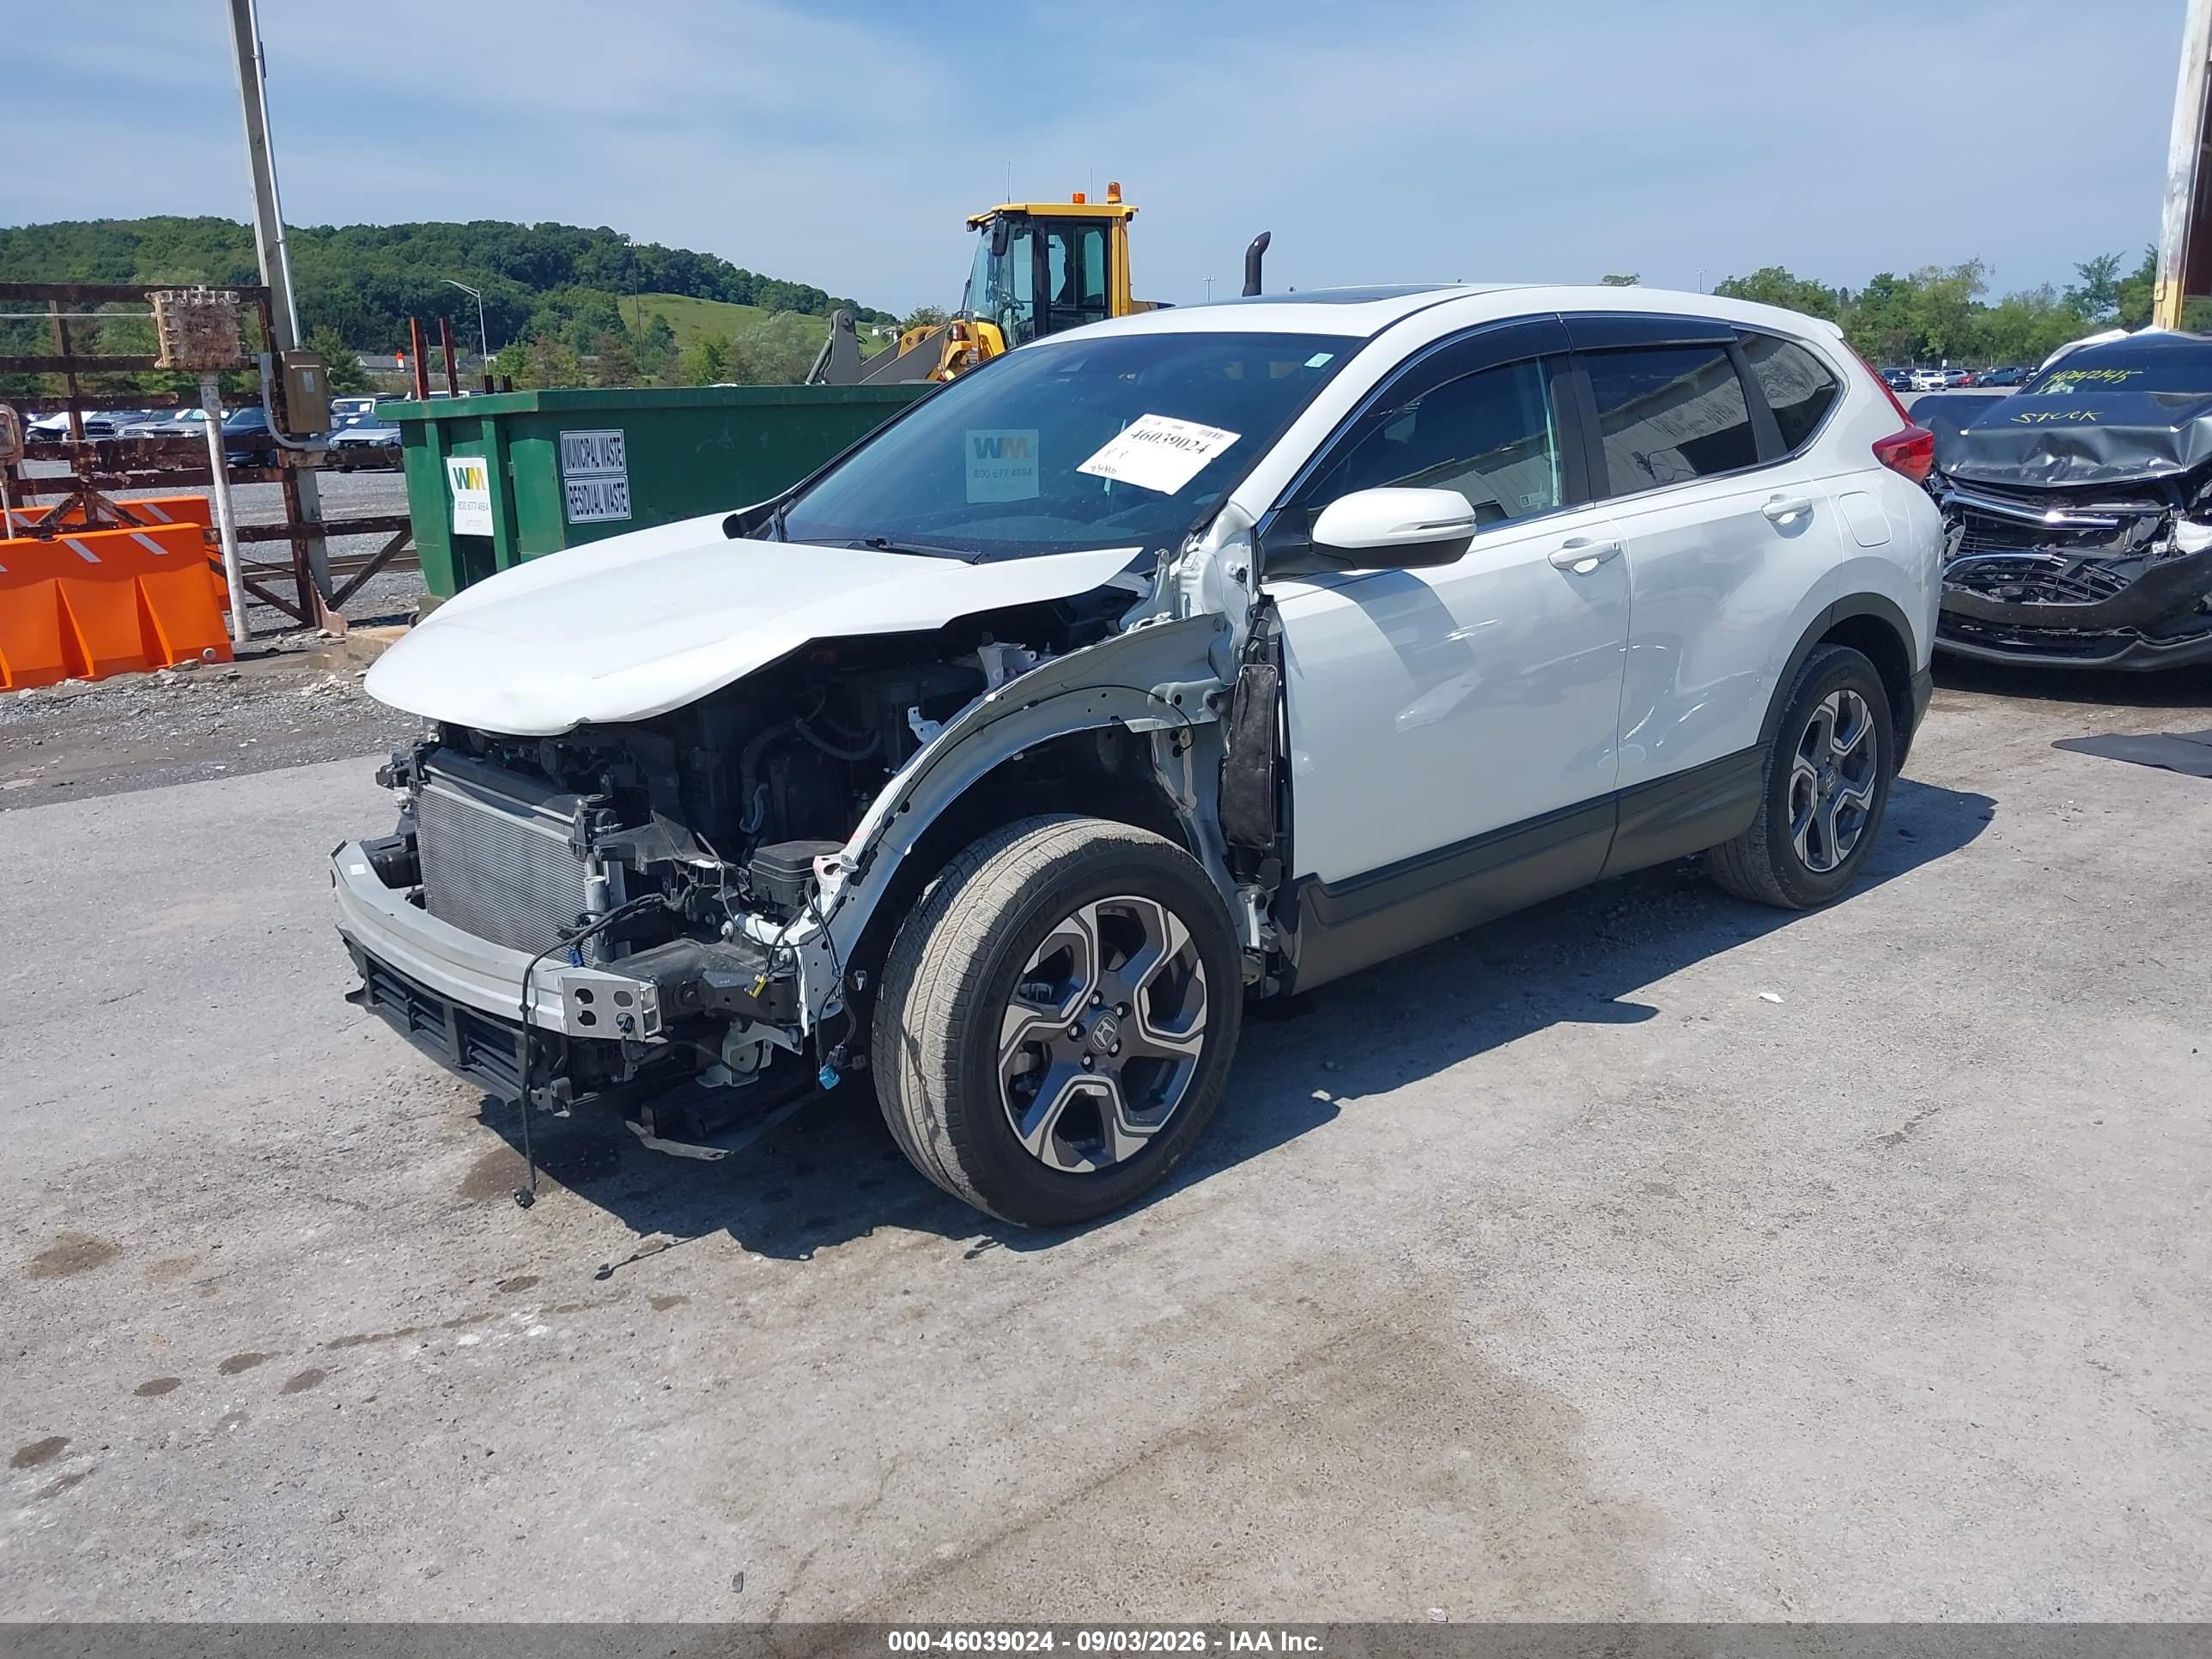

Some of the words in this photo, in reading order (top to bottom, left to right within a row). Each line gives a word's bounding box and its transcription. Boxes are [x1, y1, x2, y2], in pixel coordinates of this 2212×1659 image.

[2010, 410, 2104, 424] STUCK
[563, 438, 599, 469] MUNICIPAL
[599, 437, 623, 467] WASTE
[973, 436, 1032, 459] WM
[1130, 428, 1212, 454] 46039024
[452, 466, 487, 490] WM
[568, 484, 604, 515] RESIDUAL
[602, 483, 627, 513] WASTE
